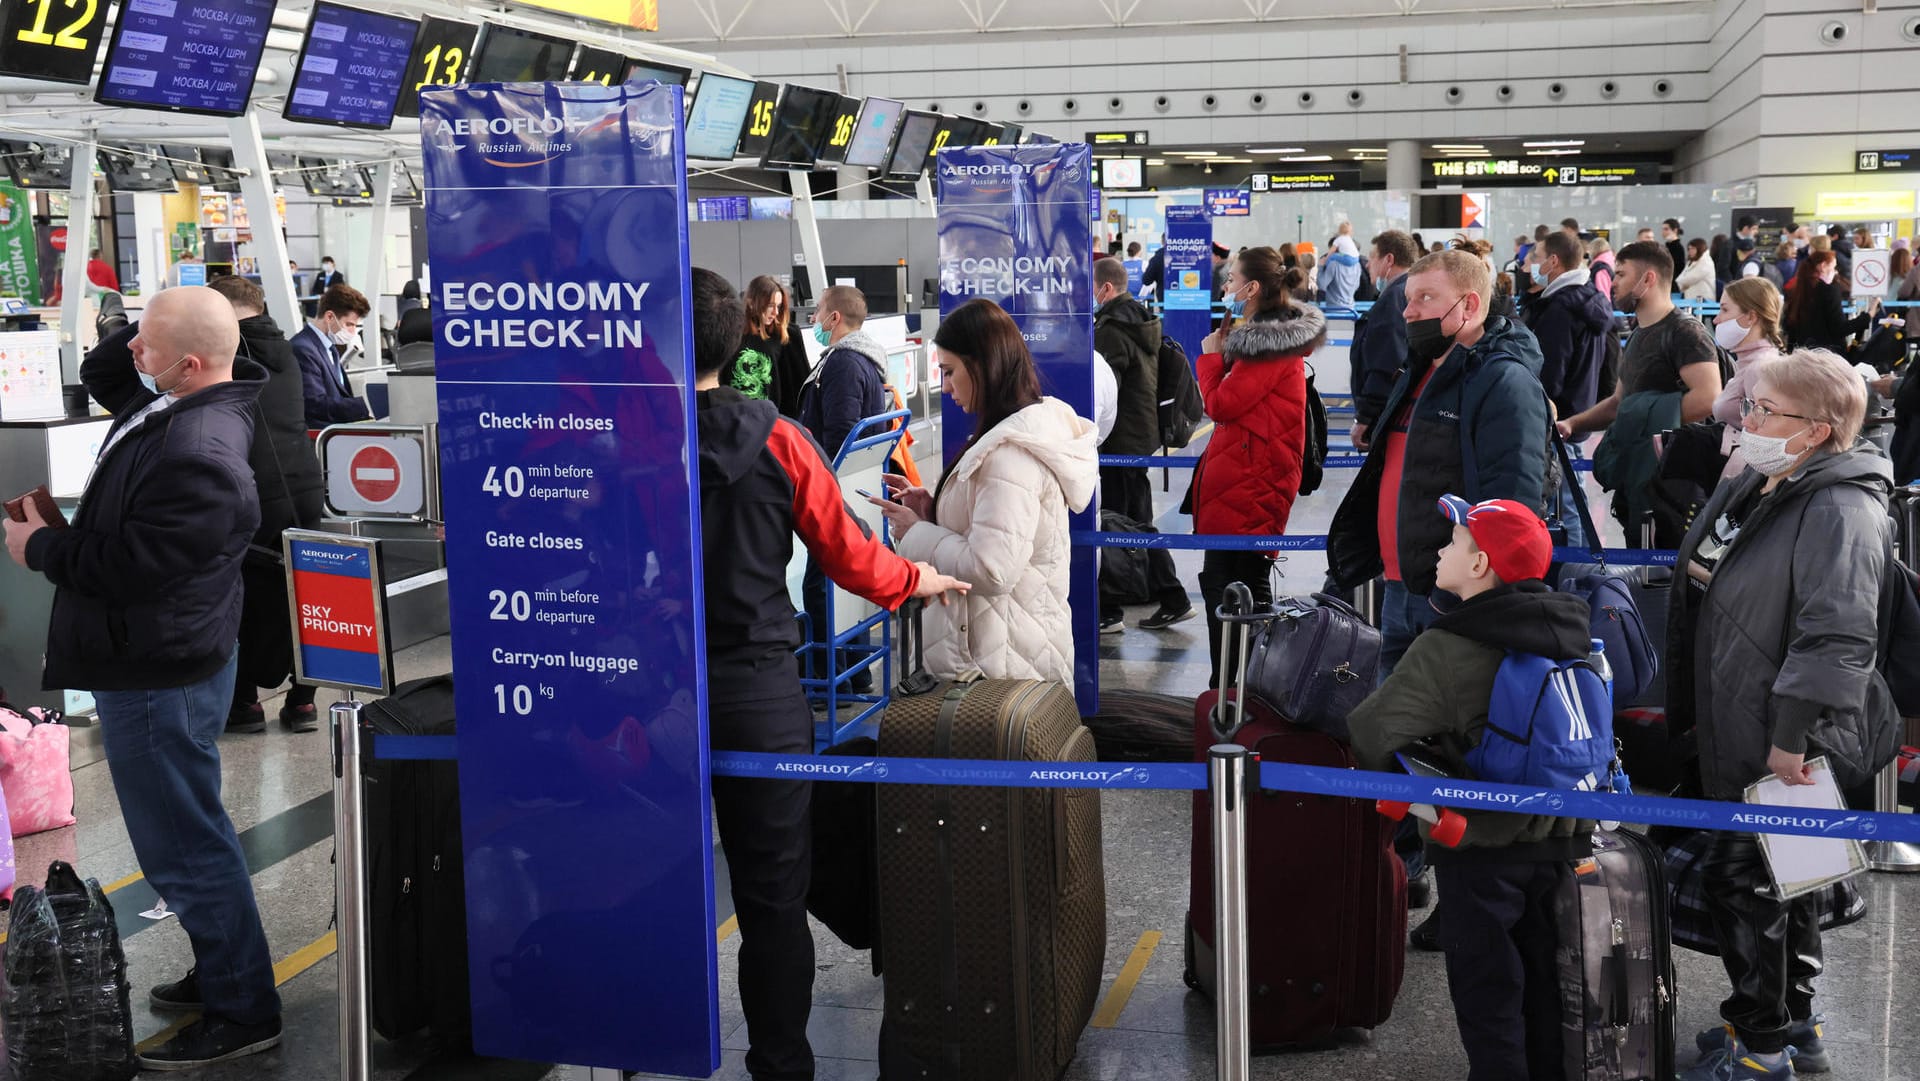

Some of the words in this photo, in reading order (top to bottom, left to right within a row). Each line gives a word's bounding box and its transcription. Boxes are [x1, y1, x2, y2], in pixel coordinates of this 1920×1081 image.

[192, 7, 228, 22] МОСКВА
[17, 0, 97, 50] 12
[183, 42, 219, 56] МОСКВА
[226, 48, 247, 59] ШРМ
[415, 44, 463, 91] 13
[172, 76, 209, 91] МОСКВА
[217, 81, 237, 92] ШРМ
[435, 117, 581, 135] AEROFLOT
[748, 99, 774, 137] 15
[830, 113, 854, 147] 16
[478, 142, 521, 153] Russian
[528, 141, 572, 152] Airlines
[929, 129, 951, 156] 17
[945, 164, 1034, 176] AEROFLOT
[1432, 162, 1464, 176] THE
[1465, 160, 1519, 175] STORE
[946, 256, 1072, 274] ECONOMY
[949, 277, 1067, 296] CHECK-IN
[442, 282, 650, 311] ECONOMY
[444, 319, 643, 348] CHECK-IN
[1020, 331, 1047, 341] loses
[479, 412, 554, 430] Check-in
[558, 414, 614, 431] closes
[528, 465, 550, 477] min
[554, 465, 594, 478] before
[482, 466, 525, 498] 40
[529, 485, 589, 501] departure
[485, 531, 525, 548] Gate
[529, 533, 583, 549] closes
[1105, 537, 1149, 545] AEROFLOT
[1254, 539, 1301, 547] AEROFLOT
[301, 549, 344, 560] AEROFLOT
[488, 589, 531, 621] 20
[534, 589, 557, 602] min
[560, 590, 599, 604] before
[302, 604, 331, 618] SKY
[536, 609, 595, 625] departure
[303, 617, 373, 637] PRIORITY
[492, 648, 565, 668] Carry-on
[570, 652, 638, 674] luggage
[494, 684, 533, 715] 10
[539, 682, 554, 699] kg
[775, 763, 850, 775] AEROFLOT
[1029, 769, 1109, 781] AEROFLOT
[1432, 787, 1519, 804] AEROFLOT
[1731, 812, 1828, 829] AEROFLOT
